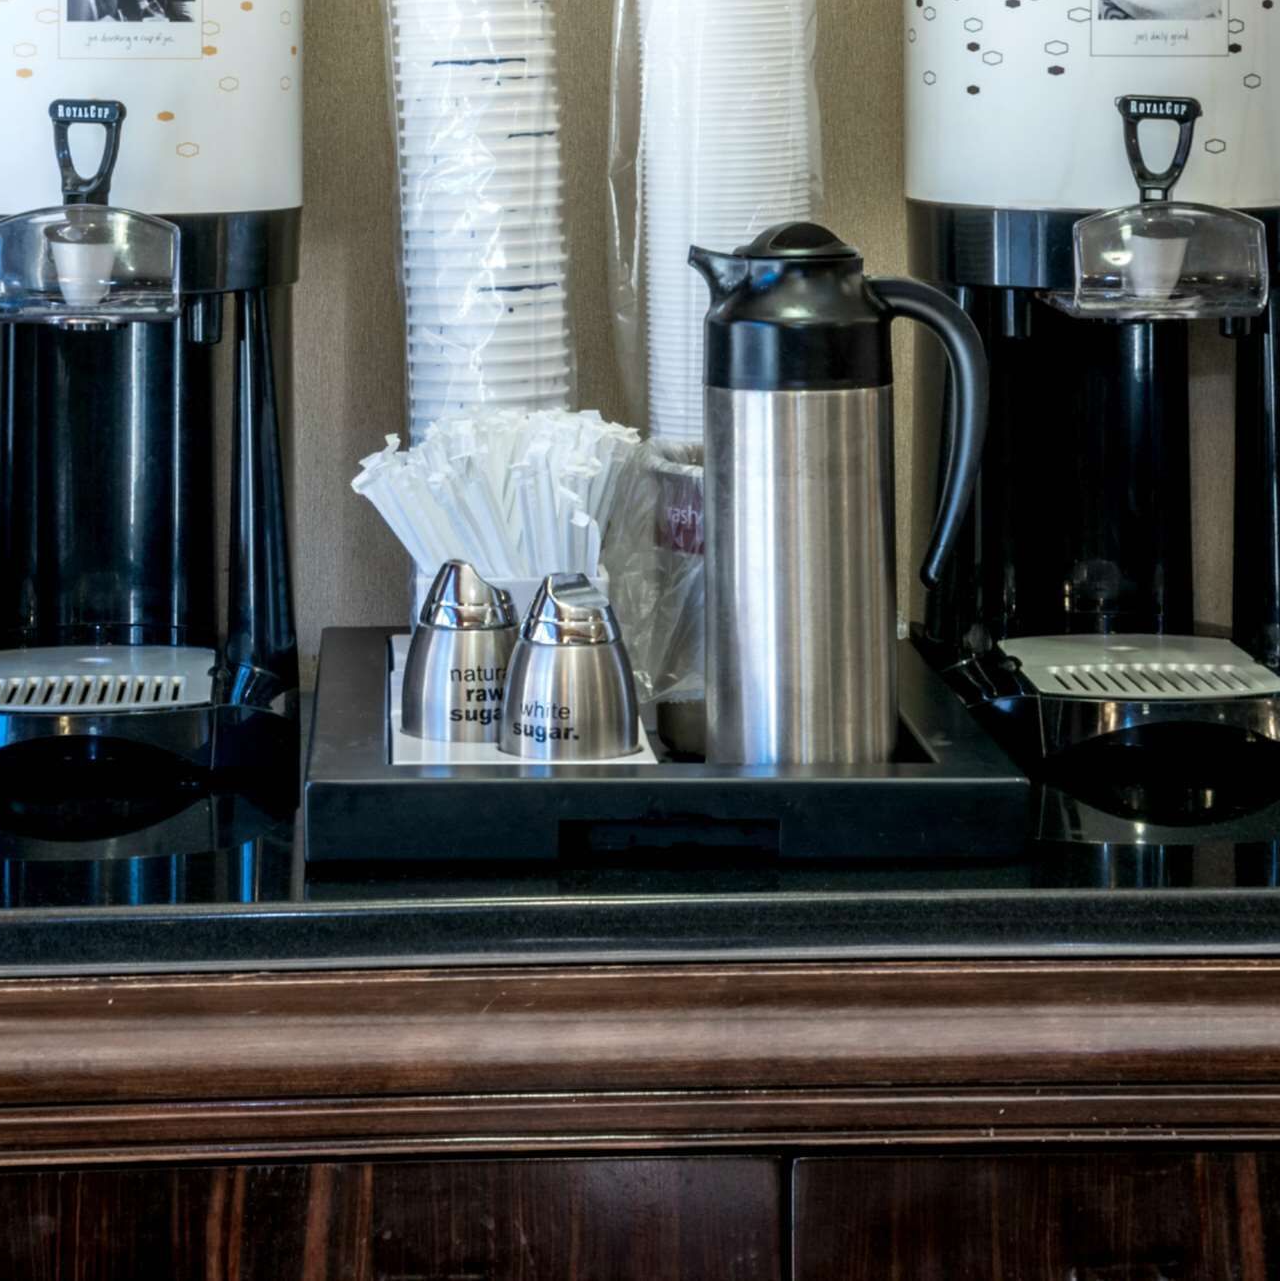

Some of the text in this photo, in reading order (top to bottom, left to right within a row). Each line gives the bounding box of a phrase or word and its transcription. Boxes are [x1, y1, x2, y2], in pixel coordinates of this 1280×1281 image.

[664, 504, 698, 526] rash
[449, 709, 504, 726] suga
[519, 699, 571, 720] white
[512, 722, 580, 743] sugar.
